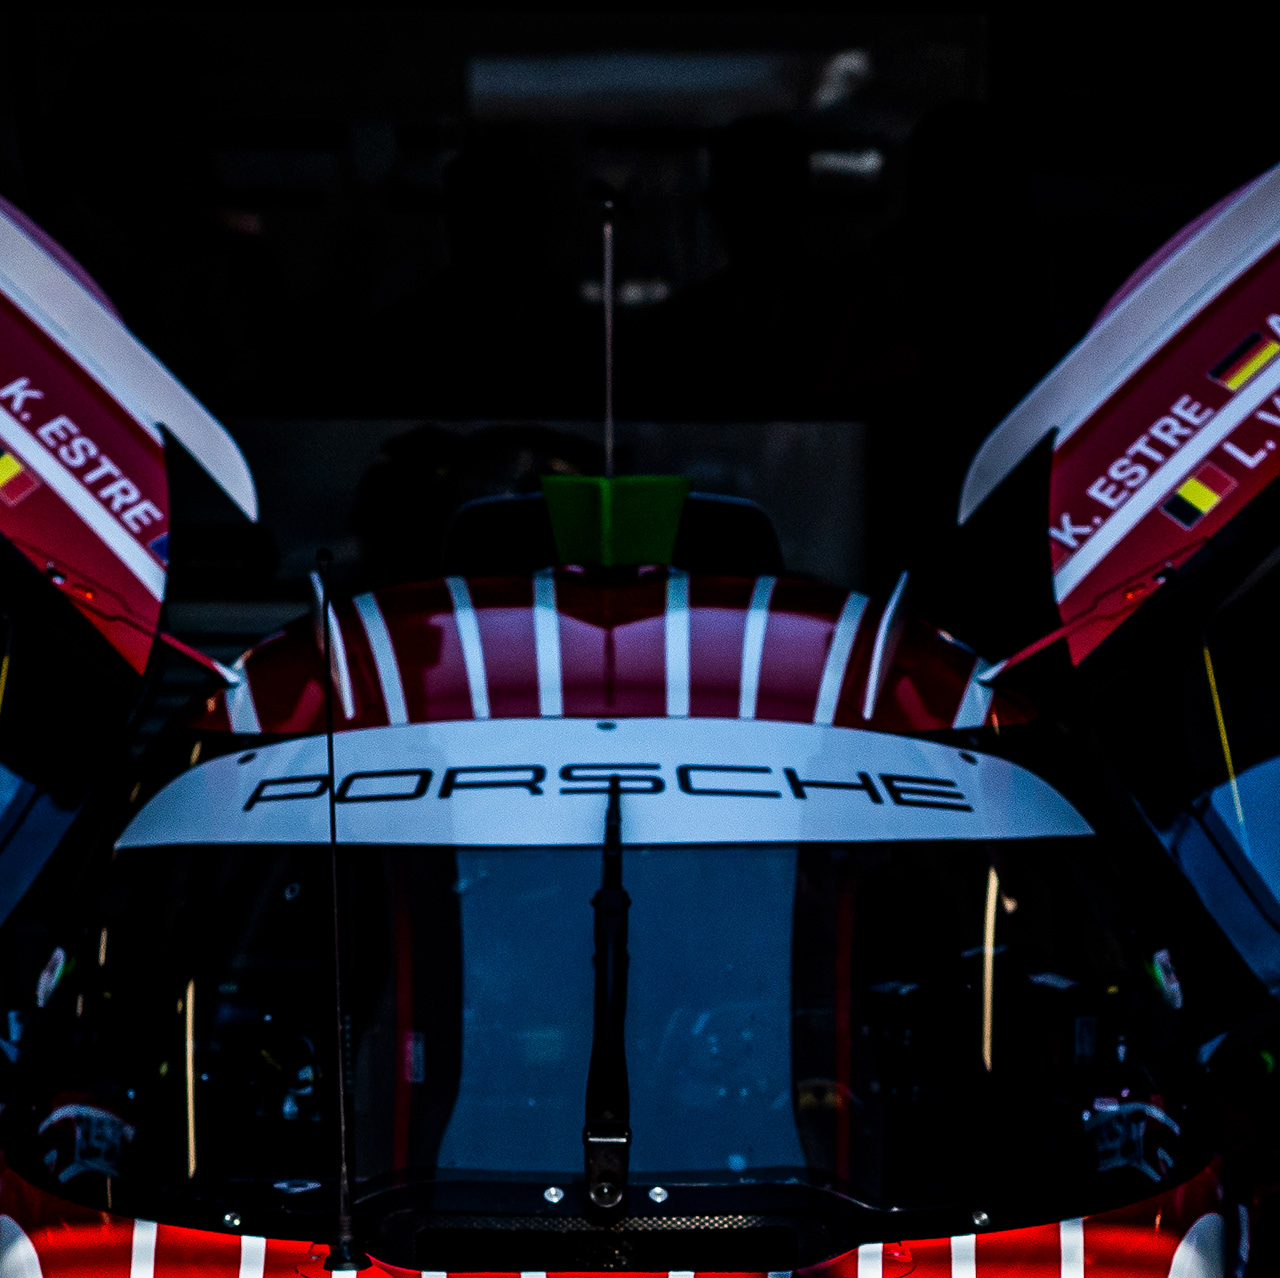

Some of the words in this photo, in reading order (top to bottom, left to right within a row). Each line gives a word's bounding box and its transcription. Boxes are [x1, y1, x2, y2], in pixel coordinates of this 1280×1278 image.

[36, 414, 164, 534] ESTRE
[1047, 513, 1103, 549] K.
[1086, 394, 1214, 510] ESTRE
[1222, 438, 1277, 470] L.
[242, 762, 975, 813] PORSCHE
